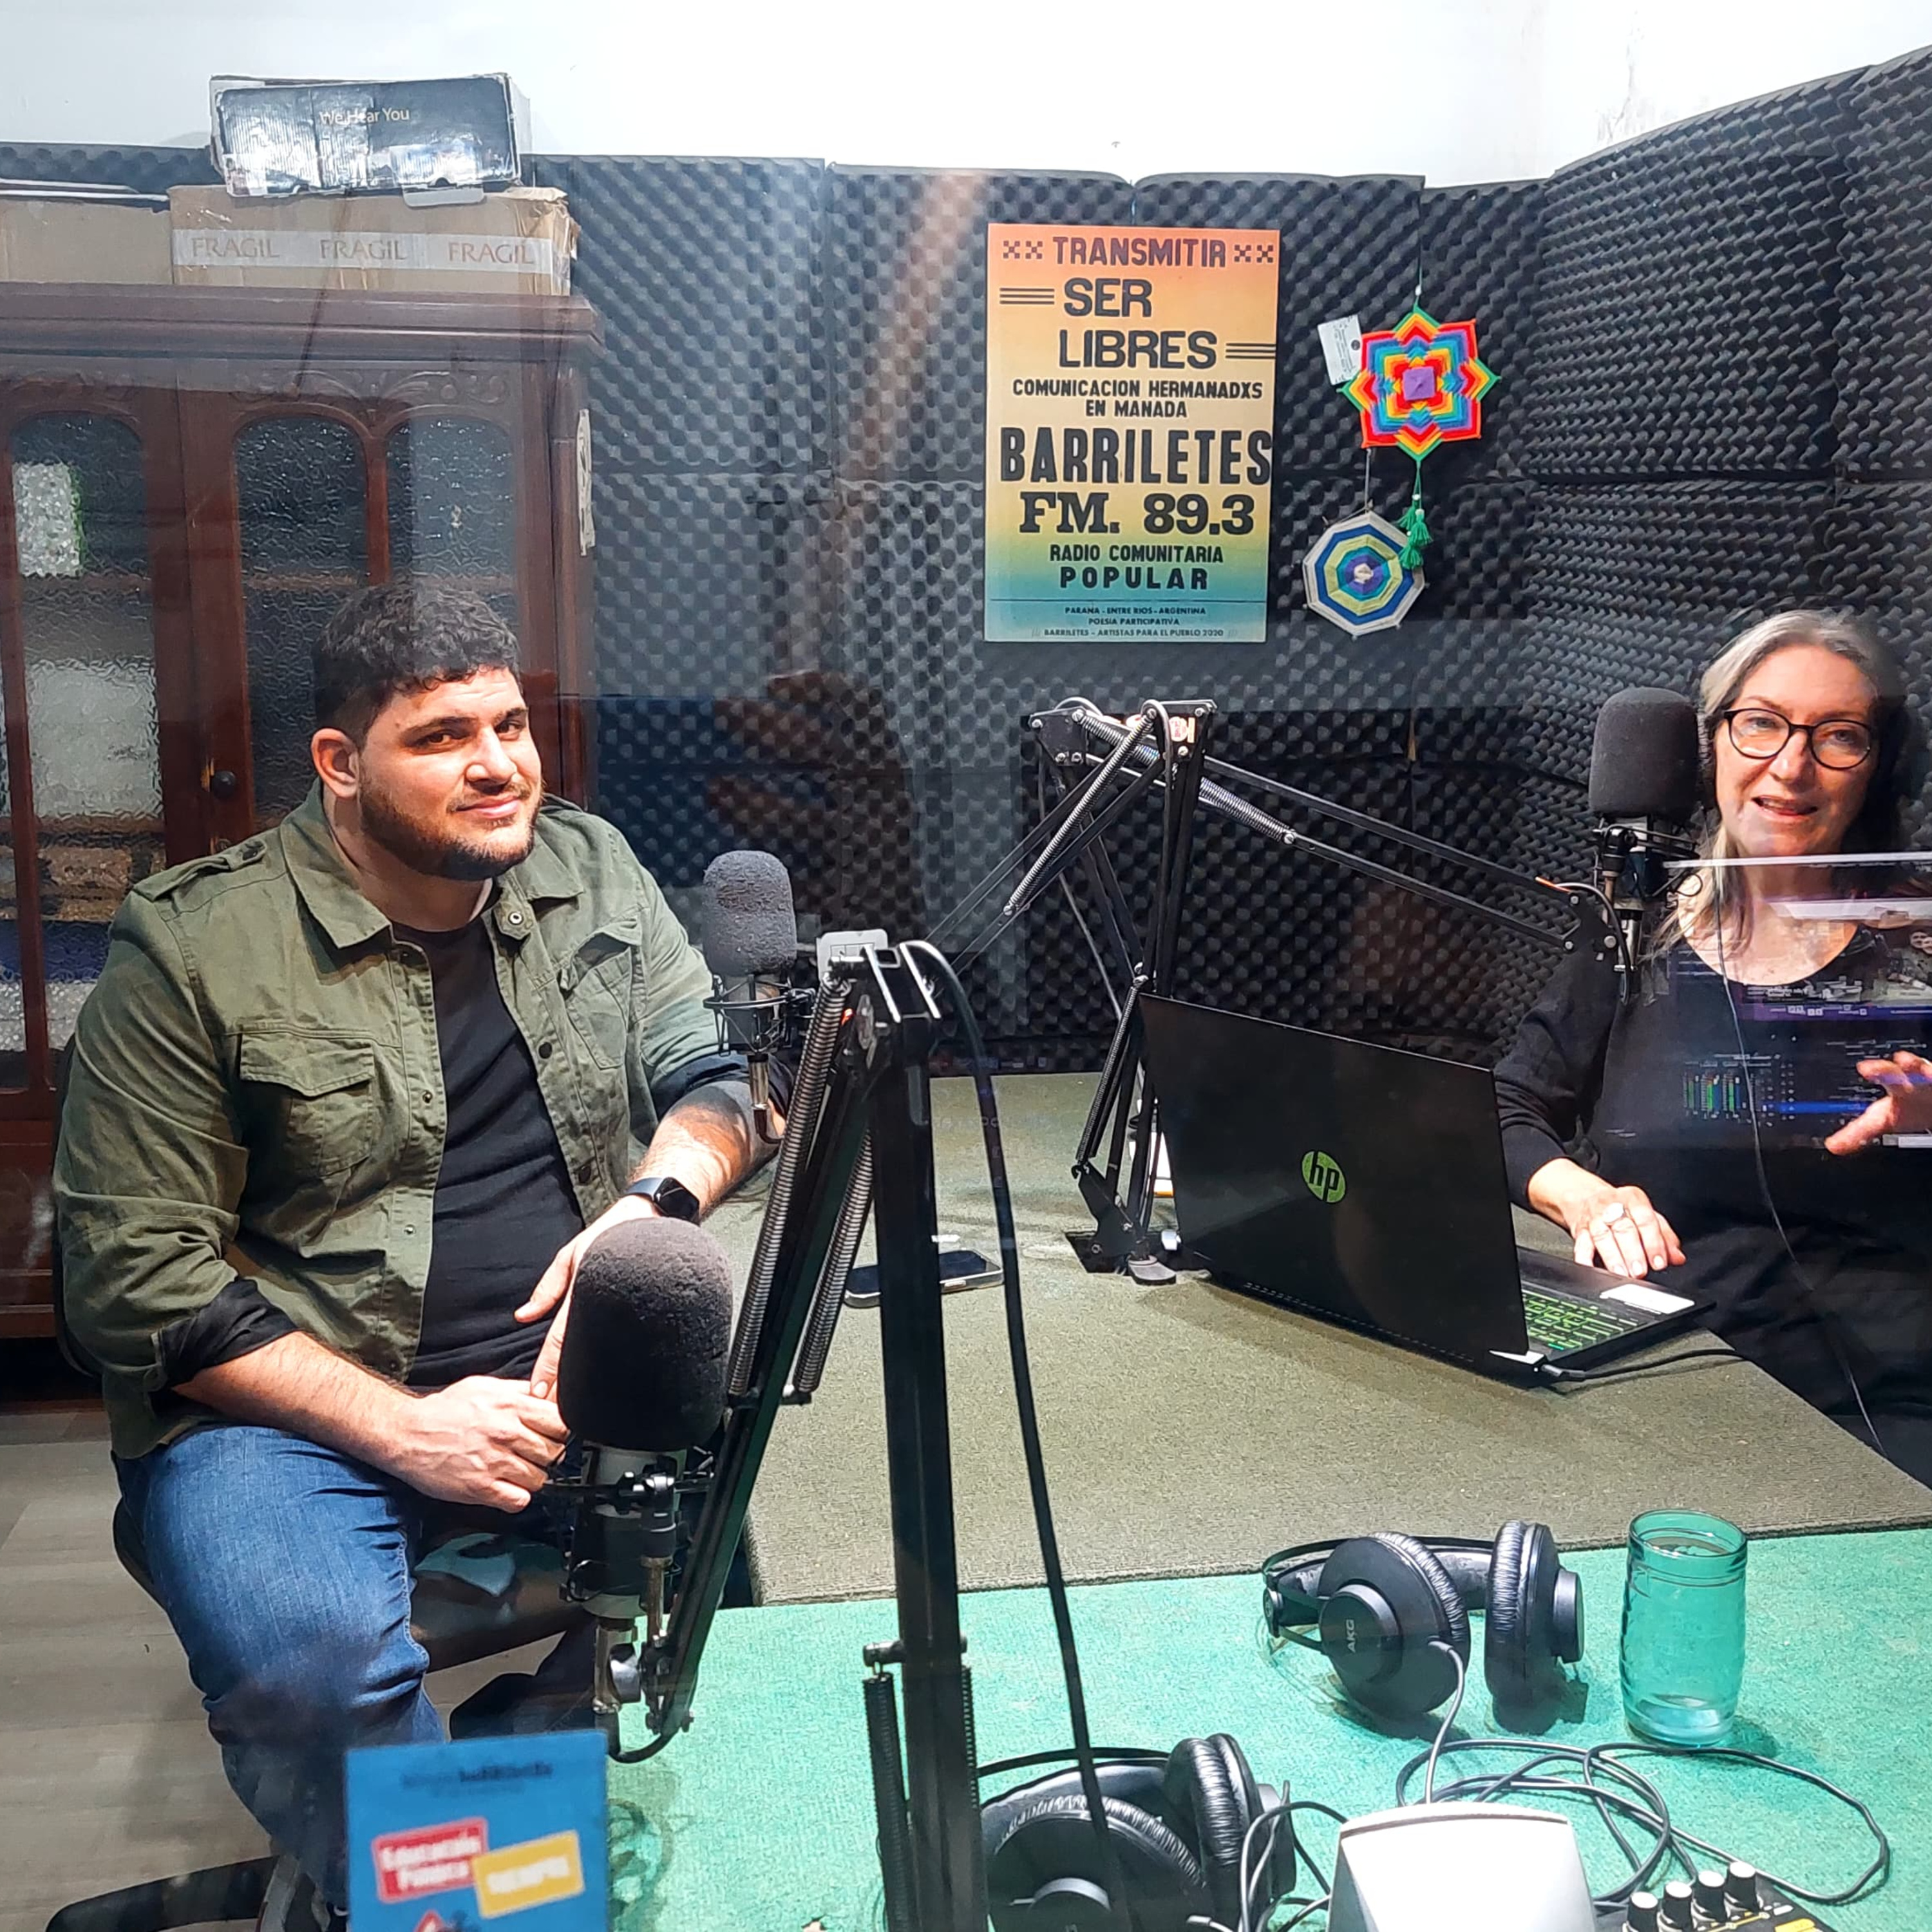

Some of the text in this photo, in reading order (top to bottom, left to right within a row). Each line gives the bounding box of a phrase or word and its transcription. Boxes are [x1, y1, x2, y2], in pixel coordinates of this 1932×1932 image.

[319, 107, 410, 125] We Hear You
[192, 238, 534, 265] FRAGIL FRAGIL FRAGIL
[1053, 236, 1226, 268] TRANSMITIR
[1064, 277, 1152, 317] SER
[1059, 329, 1217, 370] LIBRES
[1013, 379, 1263, 399] COMUNICACION HERMANADXS
[1086, 399, 1187, 419] EN MANADA
[1001, 427, 1272, 486] BARRILETES
[1019, 491, 1255, 536] FM. 89.3
[1050, 544, 1224, 564] RADIO COMUNITARIA
[1060, 566, 1208, 590] POPULAR
[1309, 1151, 1340, 1202] hp
[1346, 1619, 1356, 1653] AKG
